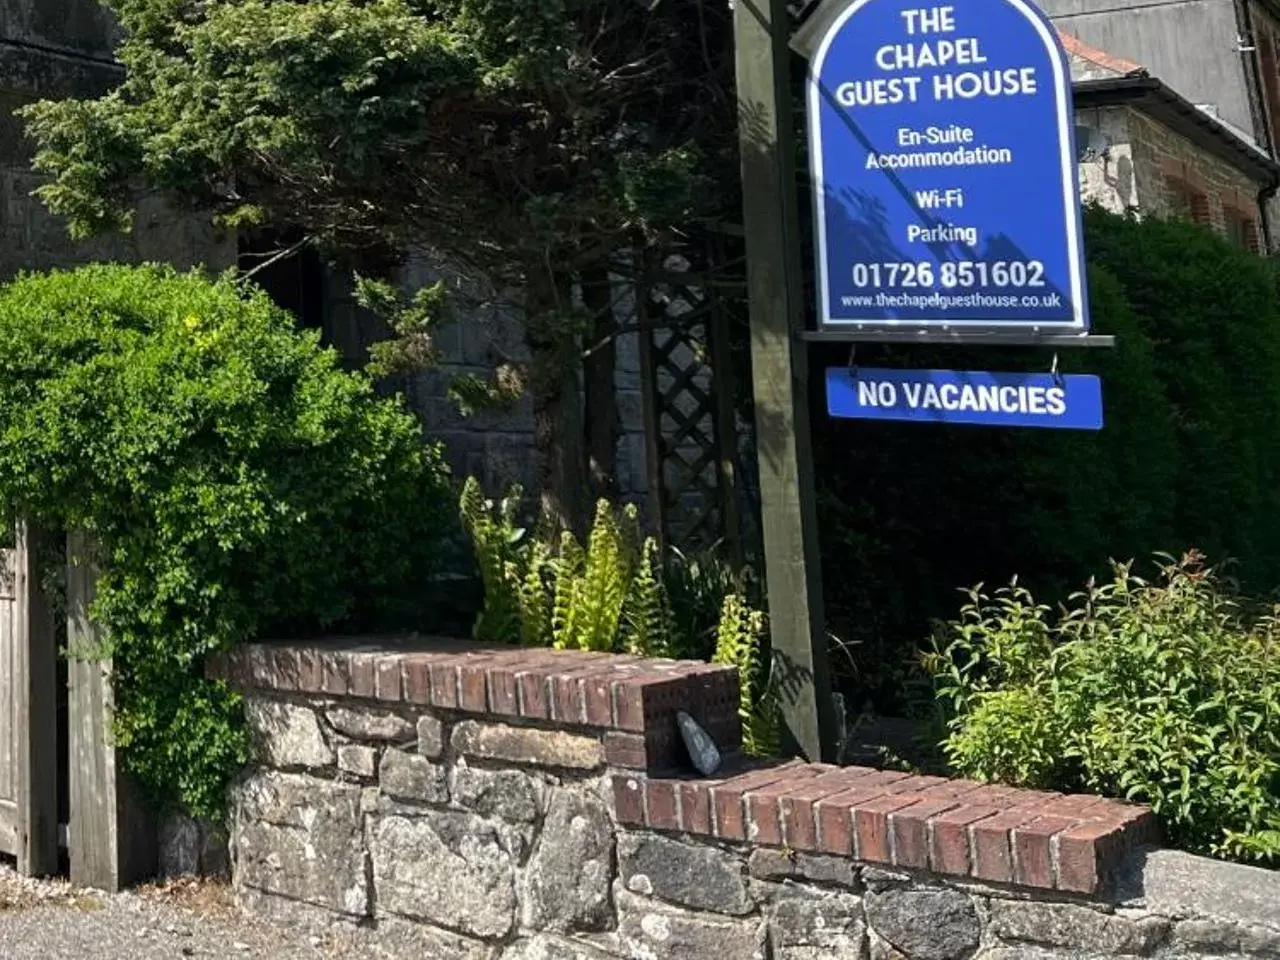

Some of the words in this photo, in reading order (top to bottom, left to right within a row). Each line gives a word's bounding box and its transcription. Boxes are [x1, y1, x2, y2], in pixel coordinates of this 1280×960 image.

[901, 6, 956, 35] THE
[875, 38, 987, 70] CHAPEL
[836, 76, 921, 107] GUEST
[933, 68, 1037, 100] HOUSE
[898, 125, 973, 146] En-Suite
[865, 146, 1011, 169] Accommodation
[916, 189, 963, 208] Wi-Fi
[907, 224, 976, 245] Parking
[852, 263, 934, 287] 01726
[940, 261, 1045, 287] 851602
[841, 292, 1061, 309] www.thechapelguesthouse.co.uk
[858, 380, 897, 406] NO
[903, 383, 1066, 415] VACANCIES
